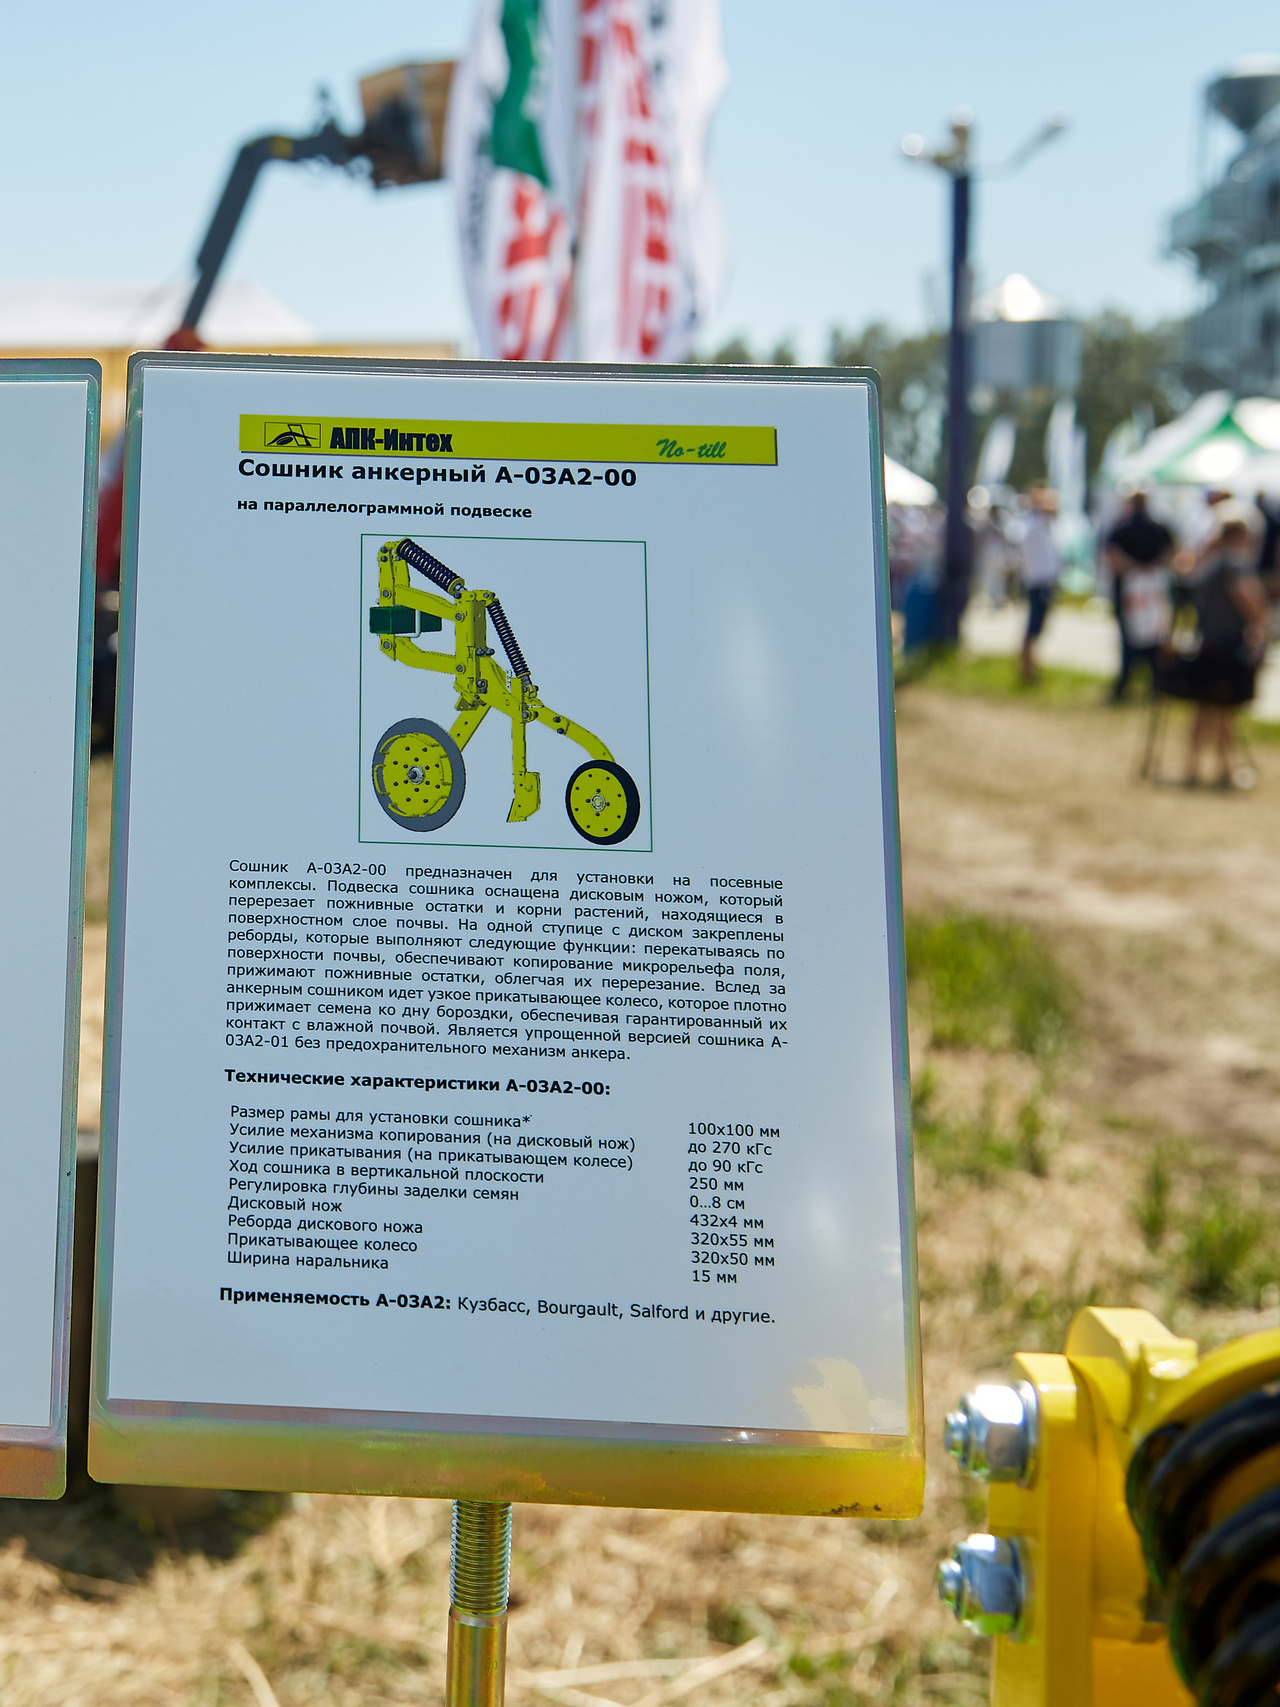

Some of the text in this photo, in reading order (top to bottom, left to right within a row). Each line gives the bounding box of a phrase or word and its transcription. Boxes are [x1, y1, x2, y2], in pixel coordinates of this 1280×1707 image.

[329, 427, 453, 453] АПК-Интех
[656, 438, 727, 459] No-till
[238, 460, 636, 486] Сошник анкерный А-03А2-00
[238, 500, 532, 518] на параллелограммной подвеске
[229, 859, 783, 890] Сошник А-03А2-00 предназначен для установки на посевные
[228, 914, 784, 942] поверхностном слое почвы. На одной ступице с диском закреплены
[228, 949, 785, 979] поверхности почвы, обеспечивают копирование микрорельефа поля,
[224, 1069, 610, 1095] Технические характеристики А-03А2-00:
[230, 1123, 635, 1152] Усилие механизма копирования (на дисковый нож)
[687, 1141, 772, 1156] до 270 кГс
[229, 1141, 633, 1170] Усилие прикатывания (на прикатывающем колесе)
[688, 1159, 763, 1174] до 90 кГс
[229, 1159, 544, 1183] Ход сошника в вертикальной плоскости
[229, 1177, 519, 1200] Регулировка глубины заделки семян
[690, 1177, 744, 1191] 250 мм
[227, 1196, 342, 1212] Дисковый нож
[228, 1214, 423, 1234] Реборда дискового ножа
[228, 1232, 417, 1252] Прикатывающее колесо
[228, 1251, 388, 1270] Ширина наральника
[693, 1270, 737, 1284] 15 мм
[220, 1287, 775, 1325] Применяемость А-03А2: Кузбасс, Bourgault, Salford и другие.
